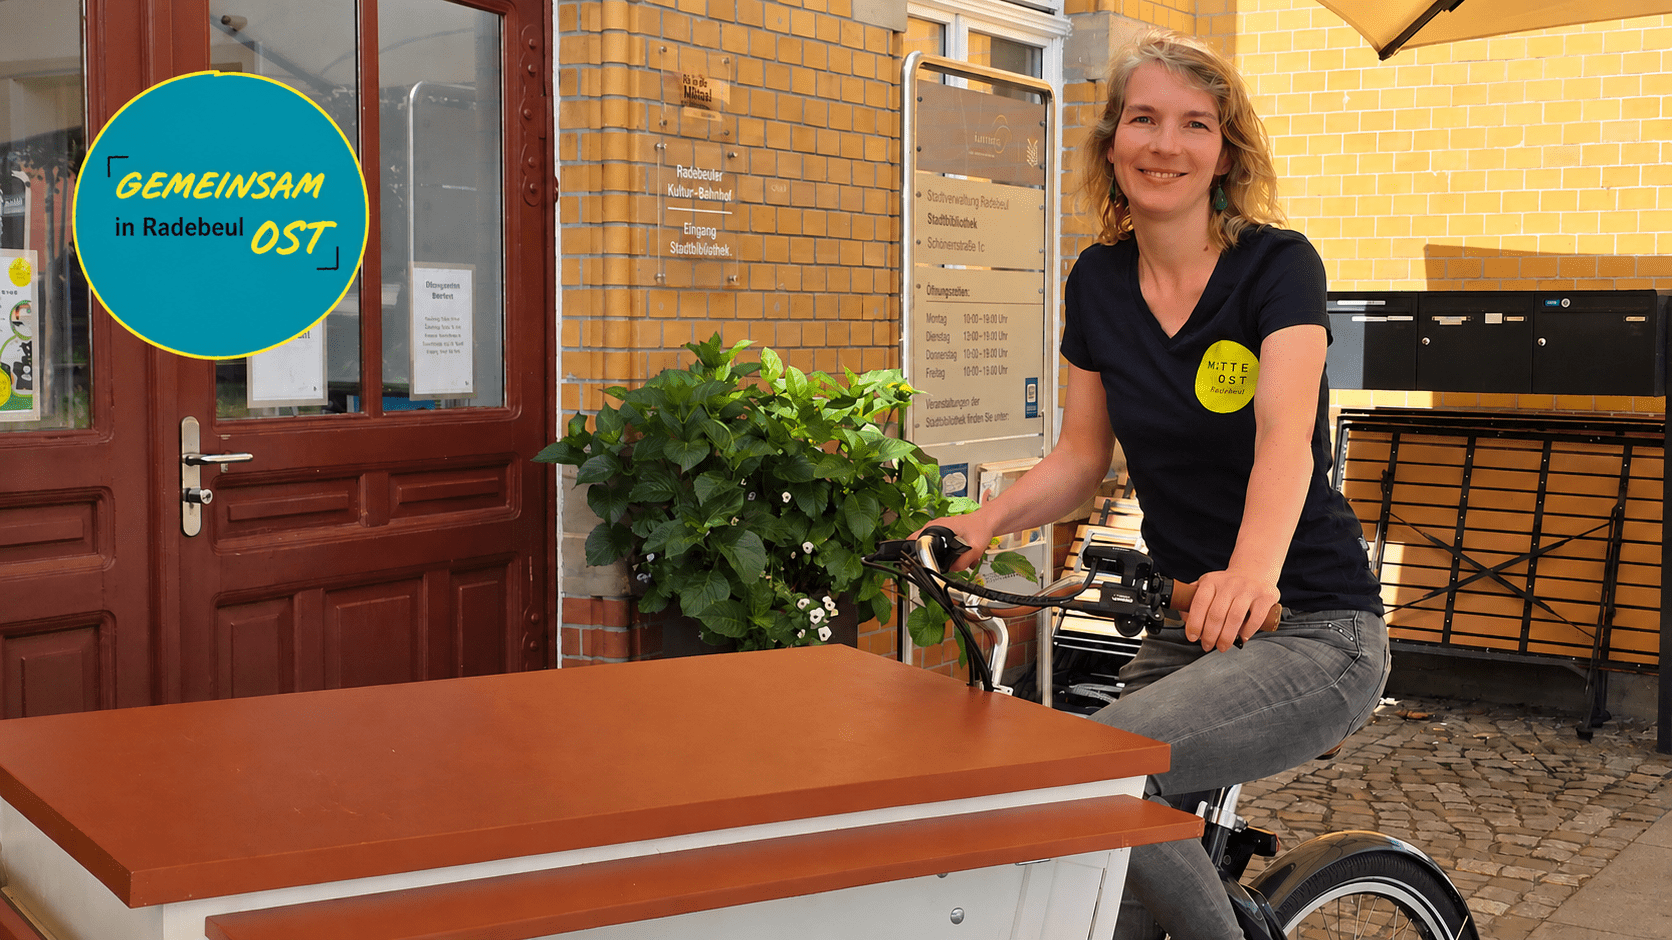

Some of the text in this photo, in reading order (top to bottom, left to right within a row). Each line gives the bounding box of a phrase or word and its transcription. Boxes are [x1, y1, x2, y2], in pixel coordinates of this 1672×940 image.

[676, 165, 723, 182] Radebeuler
[926, 189, 1010, 211] Stadtverwaltung Radebeul
[927, 212, 978, 229] Stadtbibliothek
[684, 222, 717, 240] Eingang
[926, 312, 948, 326] Montag
[998, 313, 1008, 323] Uhr
[926, 330, 951, 344] Dienstag
[998, 330, 1008, 341] Uhr
[925, 349, 957, 361] Donnerstag
[998, 347, 1008, 358] Uhr
[925, 367, 945, 380] Freitag
[998, 364, 1008, 375] Uhr
[1218, 374, 1247, 385] OST
[967, 412, 983, 424] finden
[984, 412, 993, 423] Sie
